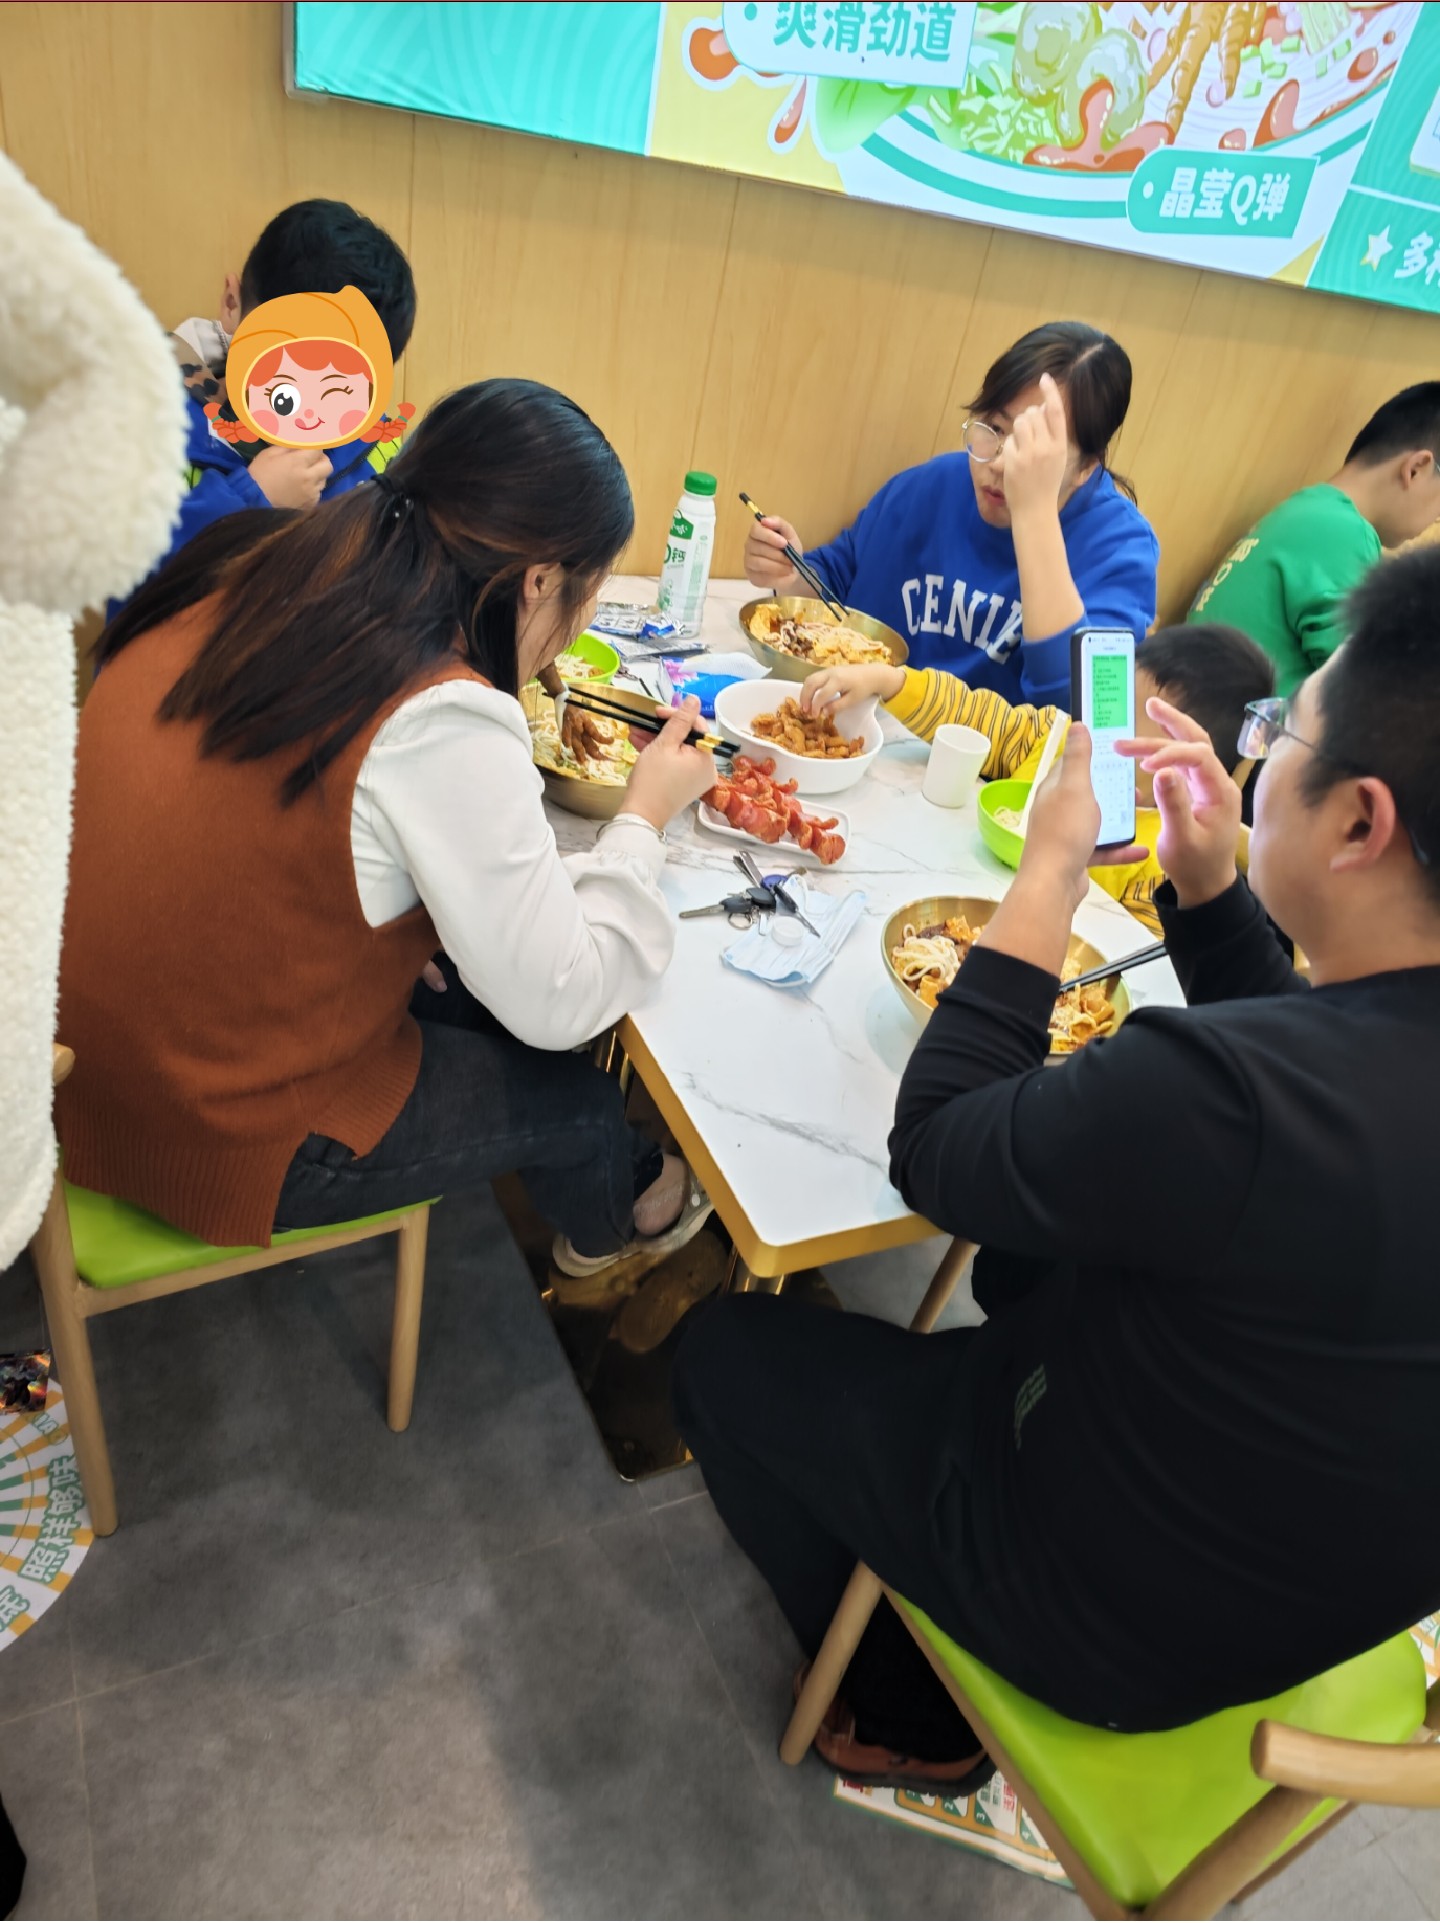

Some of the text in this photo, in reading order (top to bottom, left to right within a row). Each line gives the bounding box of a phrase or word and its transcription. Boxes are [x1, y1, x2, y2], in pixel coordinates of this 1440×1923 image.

[773, 2, 957, 62] 爽滑劲道
[1159, 167, 1291, 226] 晶莹Q弹
